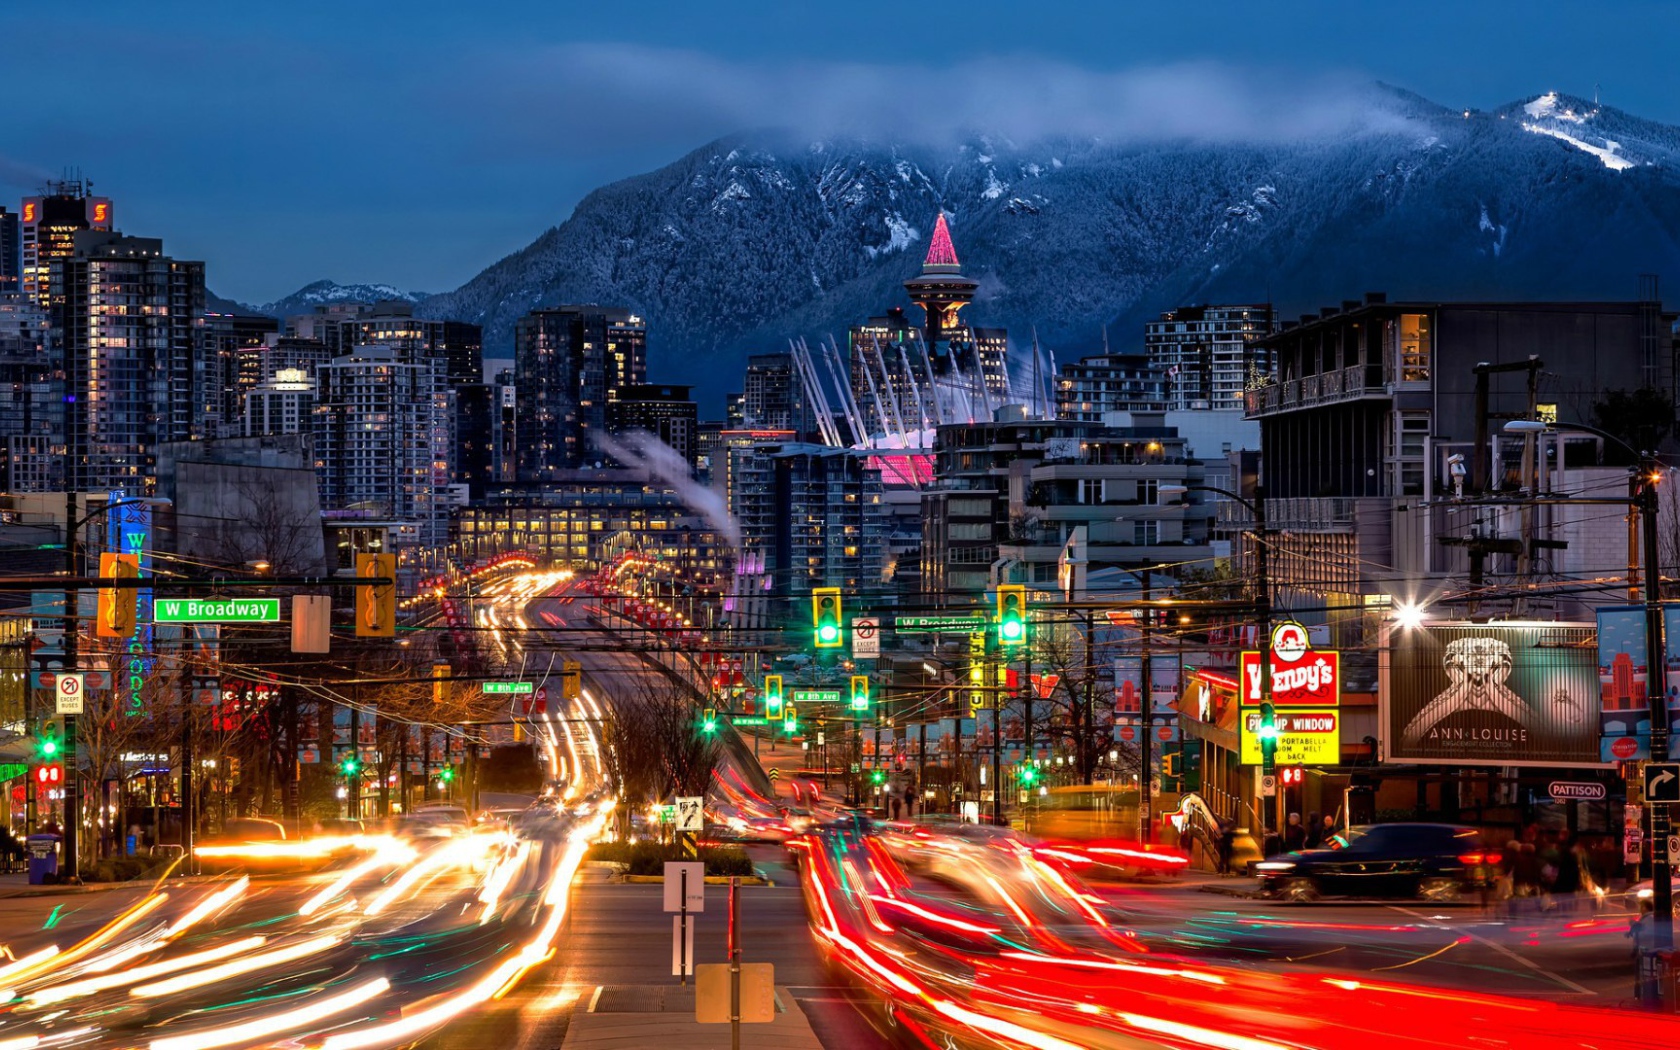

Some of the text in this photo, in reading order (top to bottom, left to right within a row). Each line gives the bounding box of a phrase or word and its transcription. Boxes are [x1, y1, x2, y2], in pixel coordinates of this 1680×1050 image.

[166, 602, 269, 619] W Broadway
[902, 620, 914, 630] W
[1293, 718, 1334, 731] WINDOW
[1430, 728, 1527, 741] ANN LOUISE
[1294, 768, 1301, 781] 8
[1553, 785, 1601, 796] PATTISON
